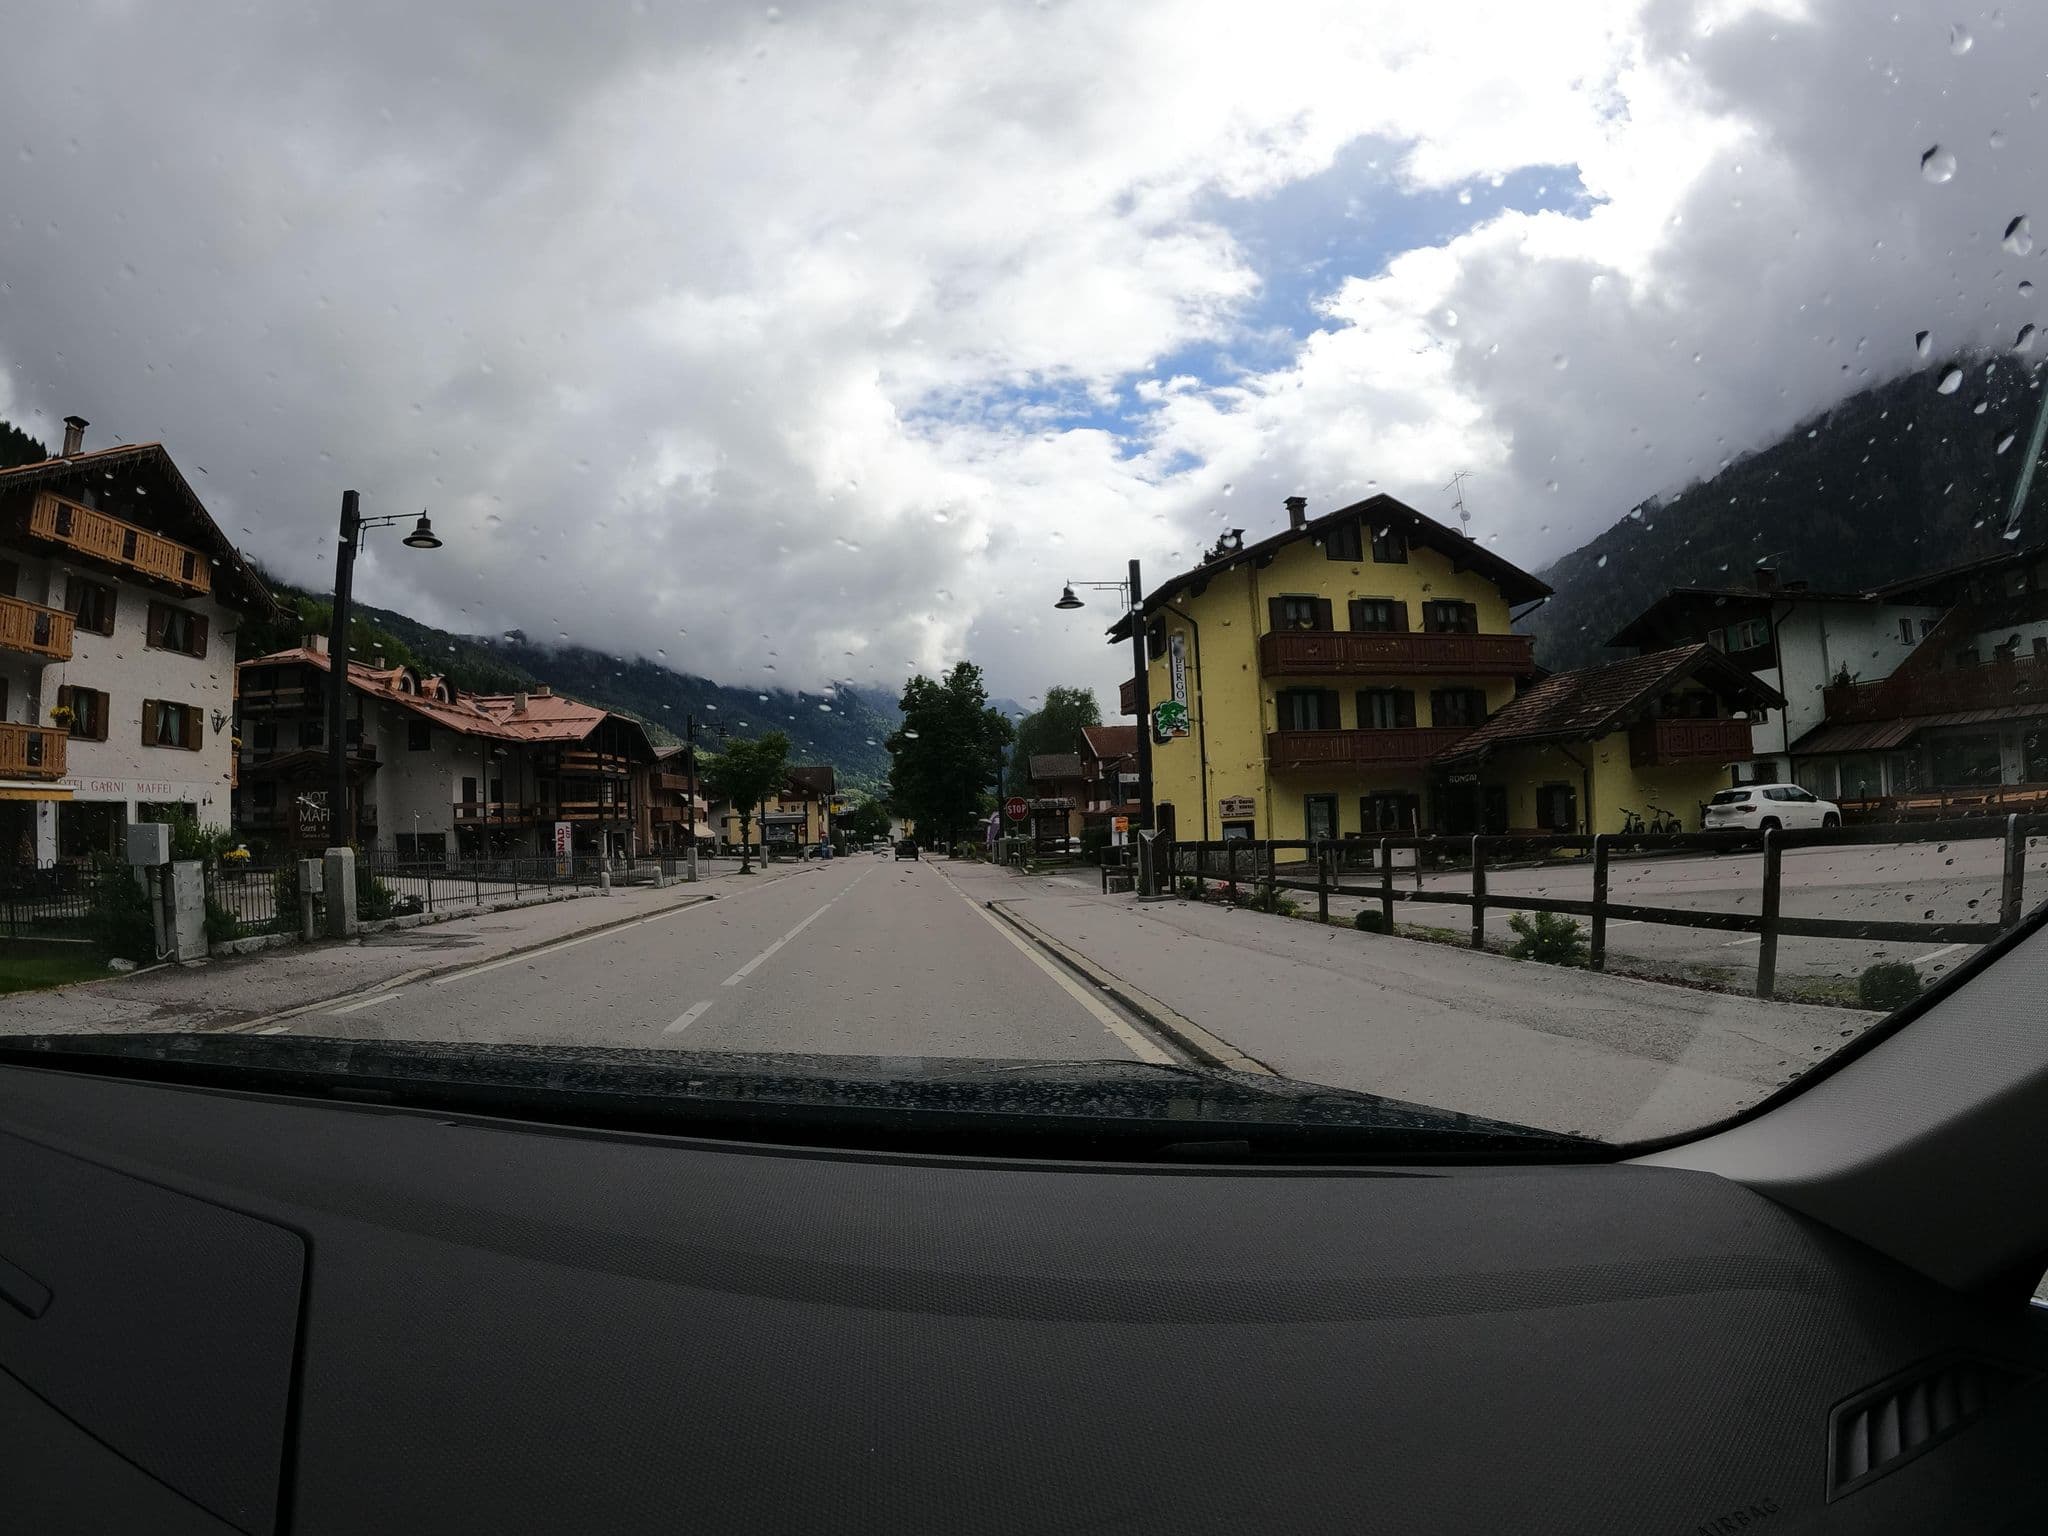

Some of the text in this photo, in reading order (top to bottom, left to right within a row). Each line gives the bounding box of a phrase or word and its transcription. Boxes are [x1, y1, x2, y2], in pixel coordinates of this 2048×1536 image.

[58, 779, 86, 791] OTEL
[137, 783, 172, 793] MAFFEI
[300, 791, 329, 805] HOT
[1008, 805, 1026, 814] STOP
[1697, 1501, 1781, 1536] AIRBAG
